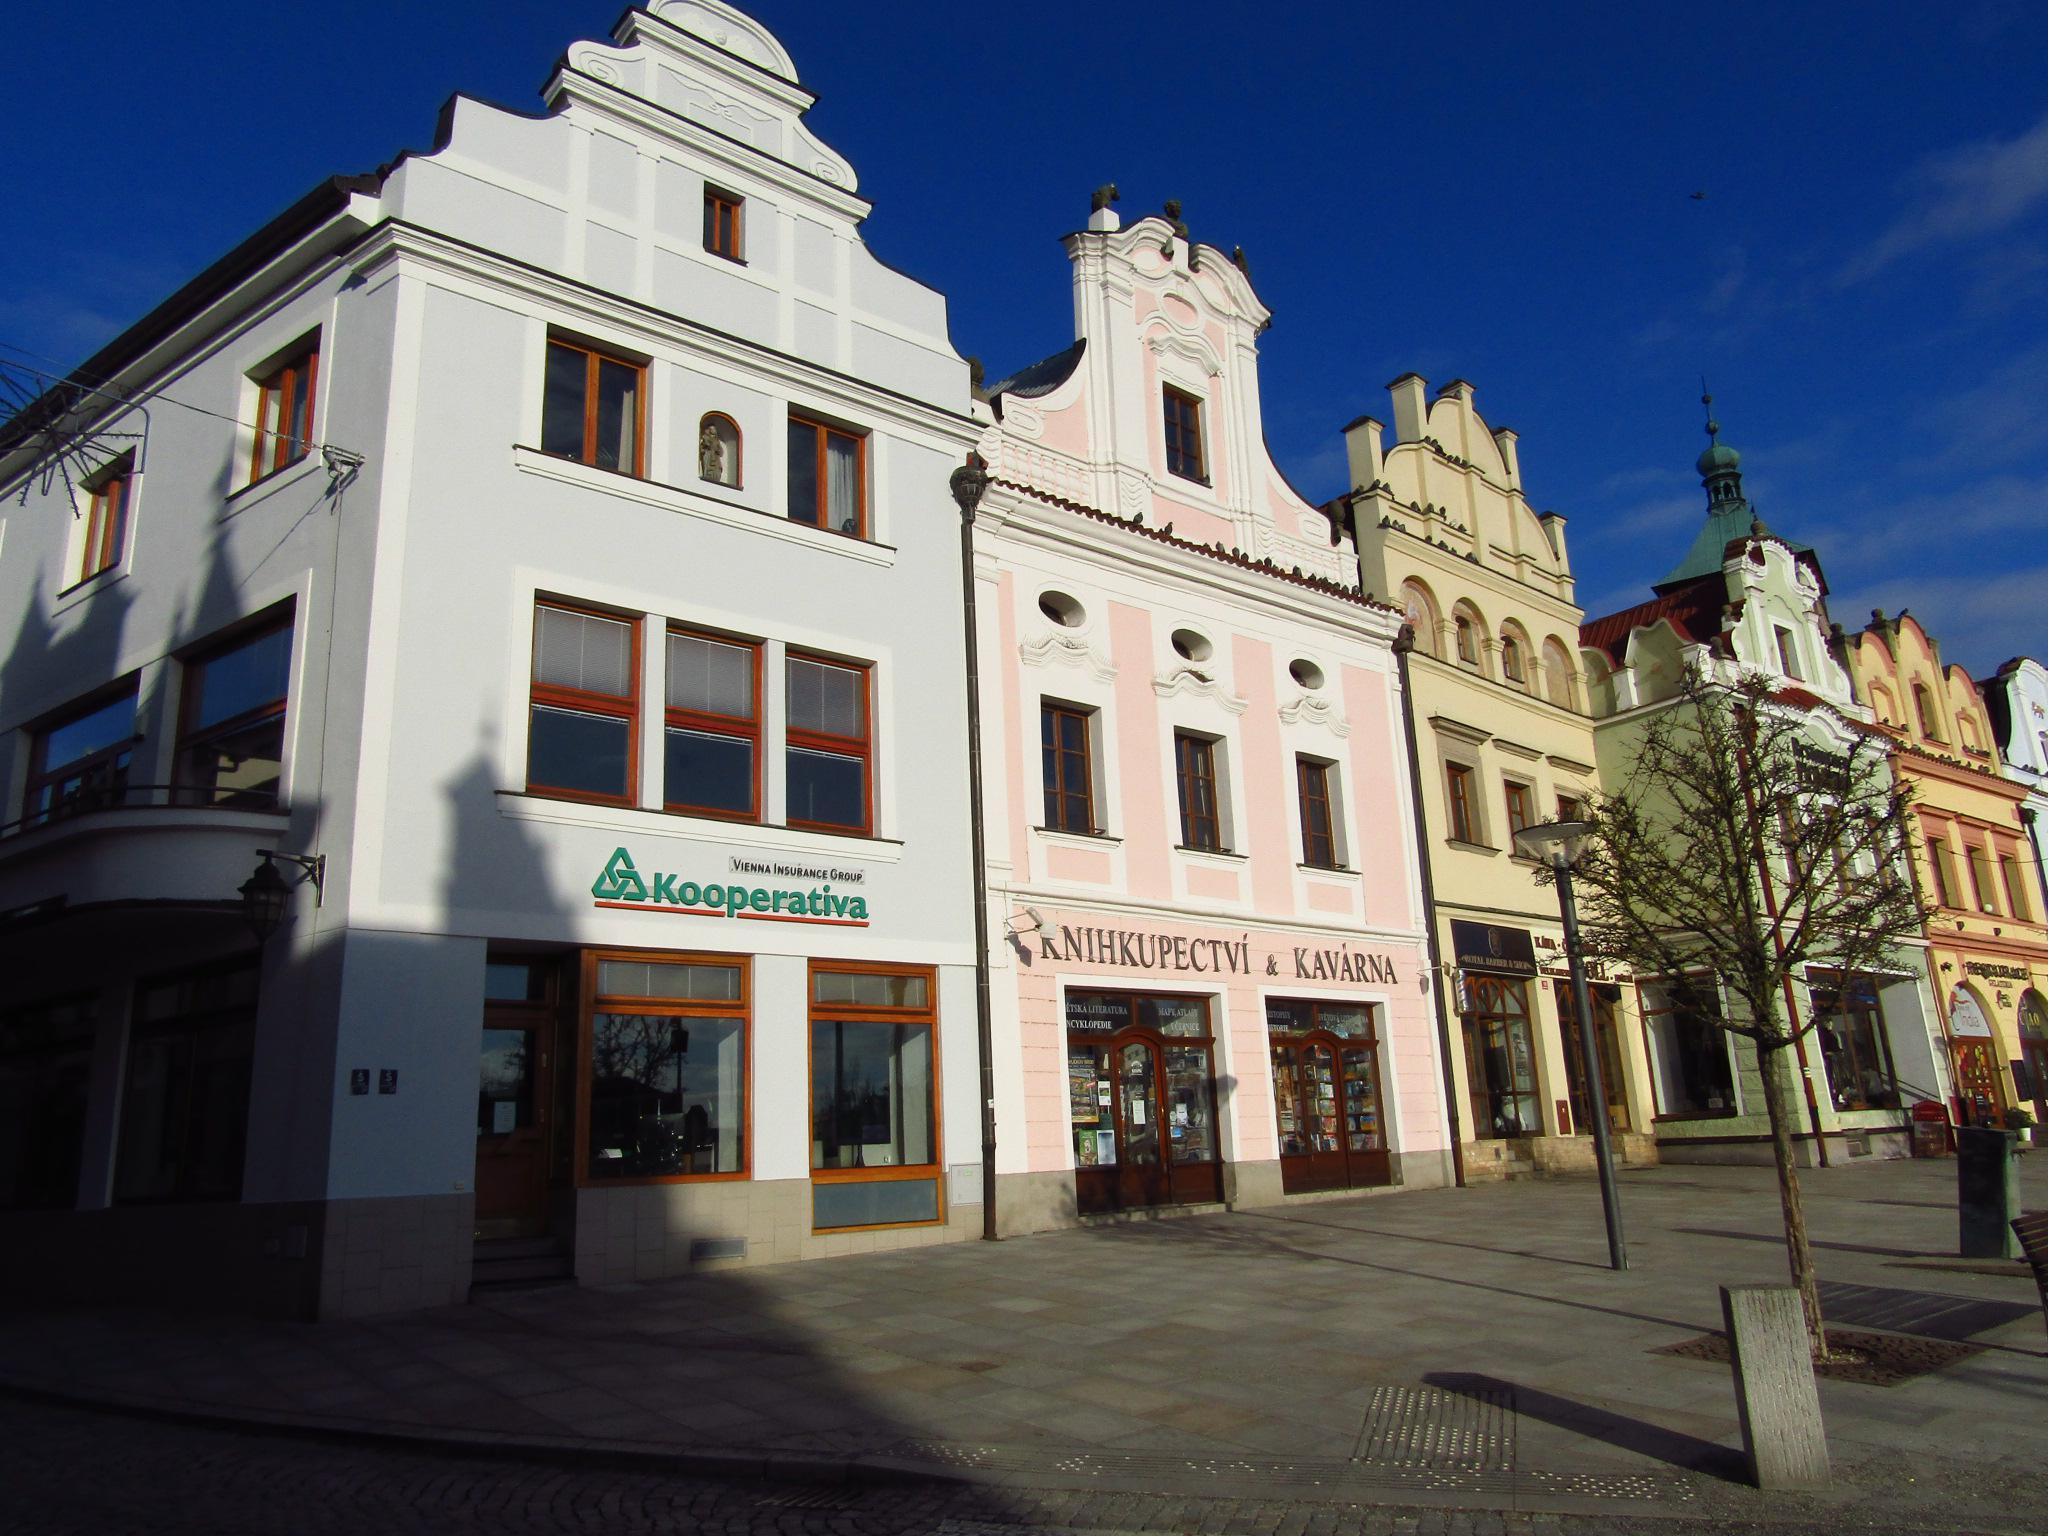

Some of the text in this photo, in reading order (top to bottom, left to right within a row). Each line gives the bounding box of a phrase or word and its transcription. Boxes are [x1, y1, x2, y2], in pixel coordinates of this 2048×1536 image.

[733, 859, 864, 883] VIENNA INSURANCE GROUP
[653, 872, 869, 919] Kooperativa
[1040, 925, 1399, 985] KNIHKUPECTVÍ & KAVÁRNA
[1066, 1002, 1128, 1015] ĚTSKÁ LITERATURA
[1066, 1019, 1112, 1029] NCYKLOPEDIE
[1268, 1024, 1289, 1032] ISTORIE
